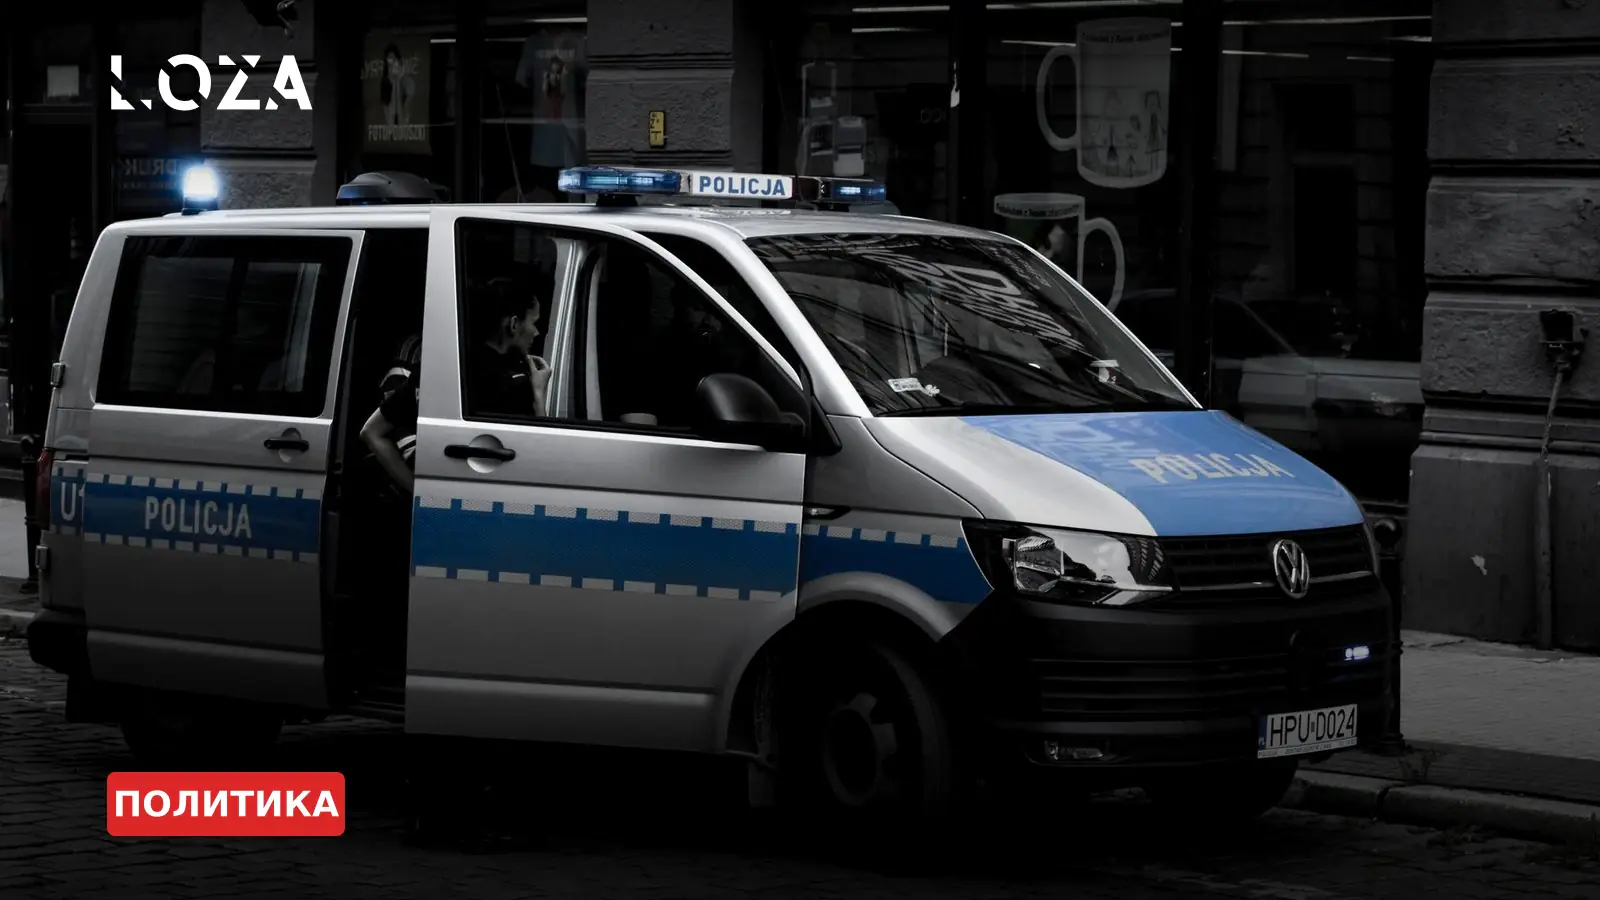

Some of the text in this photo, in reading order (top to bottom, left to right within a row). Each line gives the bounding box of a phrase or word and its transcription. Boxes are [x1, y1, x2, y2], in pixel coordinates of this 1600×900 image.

[699, 175, 786, 196] POLICJA
[1128, 453, 1296, 484] POLICJA
[145, 496, 252, 539] POLICJA
